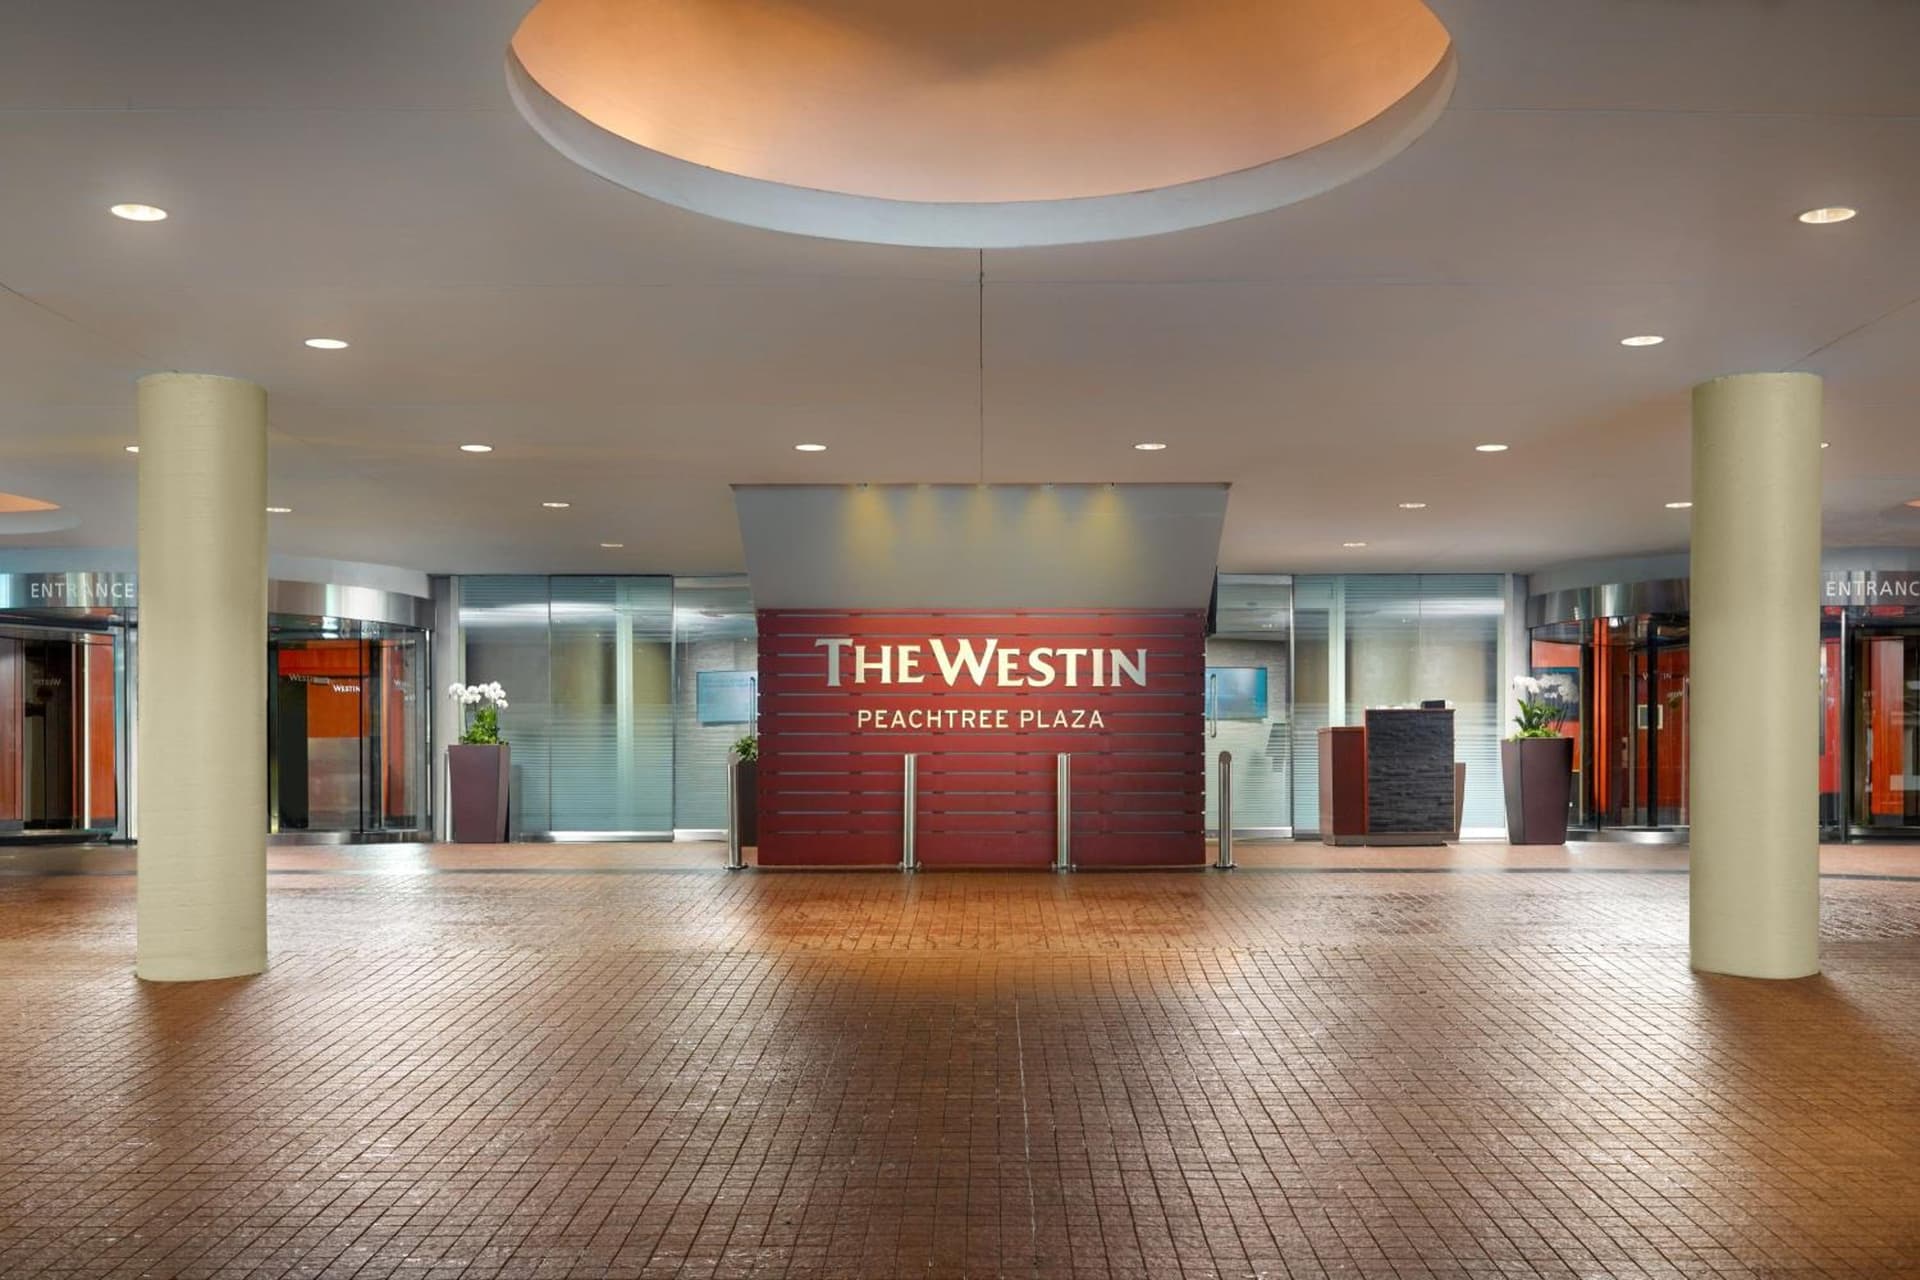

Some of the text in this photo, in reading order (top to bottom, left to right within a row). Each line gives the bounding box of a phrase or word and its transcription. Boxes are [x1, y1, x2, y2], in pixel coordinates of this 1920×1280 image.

[31, 583, 135, 598] ENTRANCE
[814, 638, 1148, 687] THE WESTIN
[857, 709, 1105, 729] PEACHTREE PLAZA
